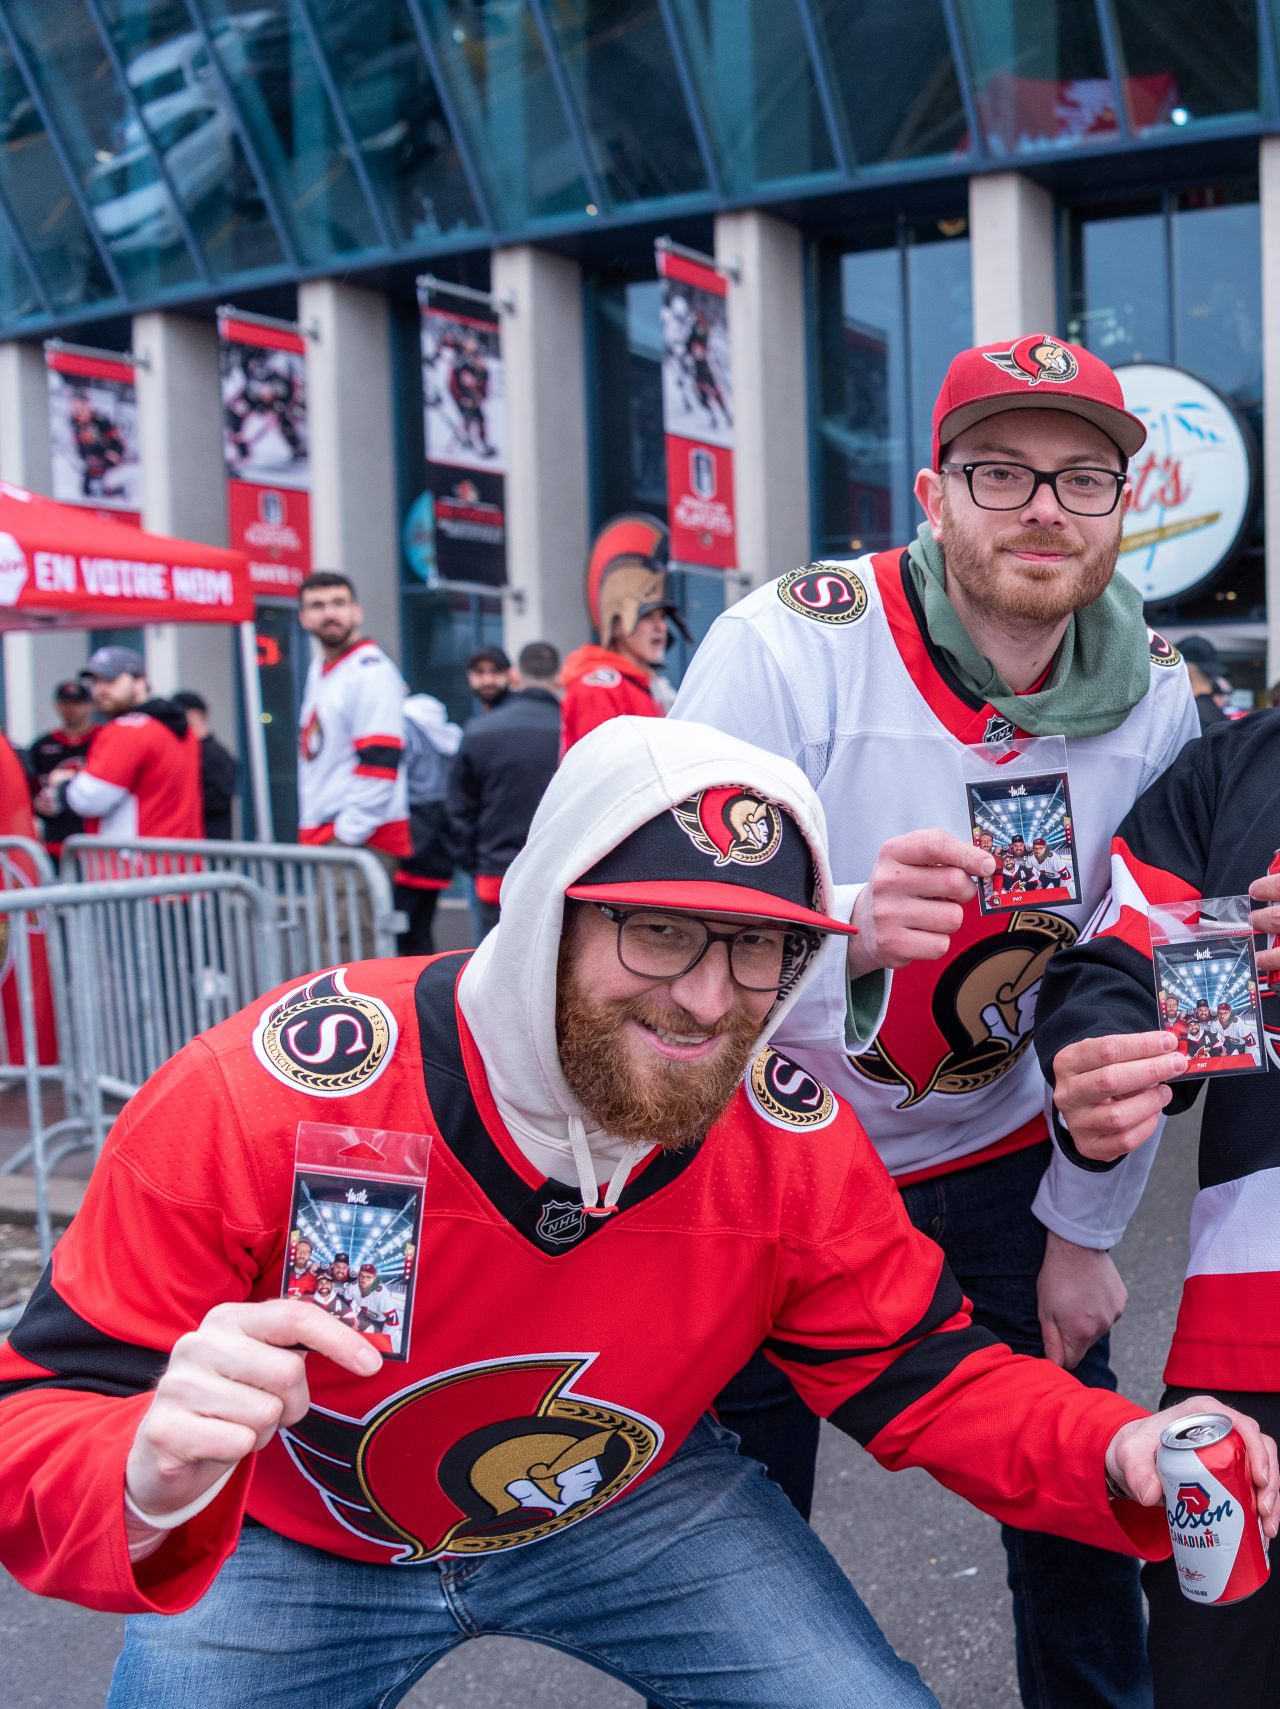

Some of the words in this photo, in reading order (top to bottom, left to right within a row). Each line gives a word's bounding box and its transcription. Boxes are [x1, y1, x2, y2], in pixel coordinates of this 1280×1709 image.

[1125, 452, 1192, 512] t's
[33, 551, 77, 593] EN
[79, 556, 169, 600] VOTRE
[171, 565, 234, 607] NOM
[791, 575, 852, 608] S
[991, 727, 1011, 743] NHL
[285, 1013, 367, 1065] S
[369, 1013, 385, 1037] EST.
[771, 1056, 821, 1107] S
[547, 1213, 579, 1234] NHL
[1170, 1528, 1215, 1549] CANADIAN
